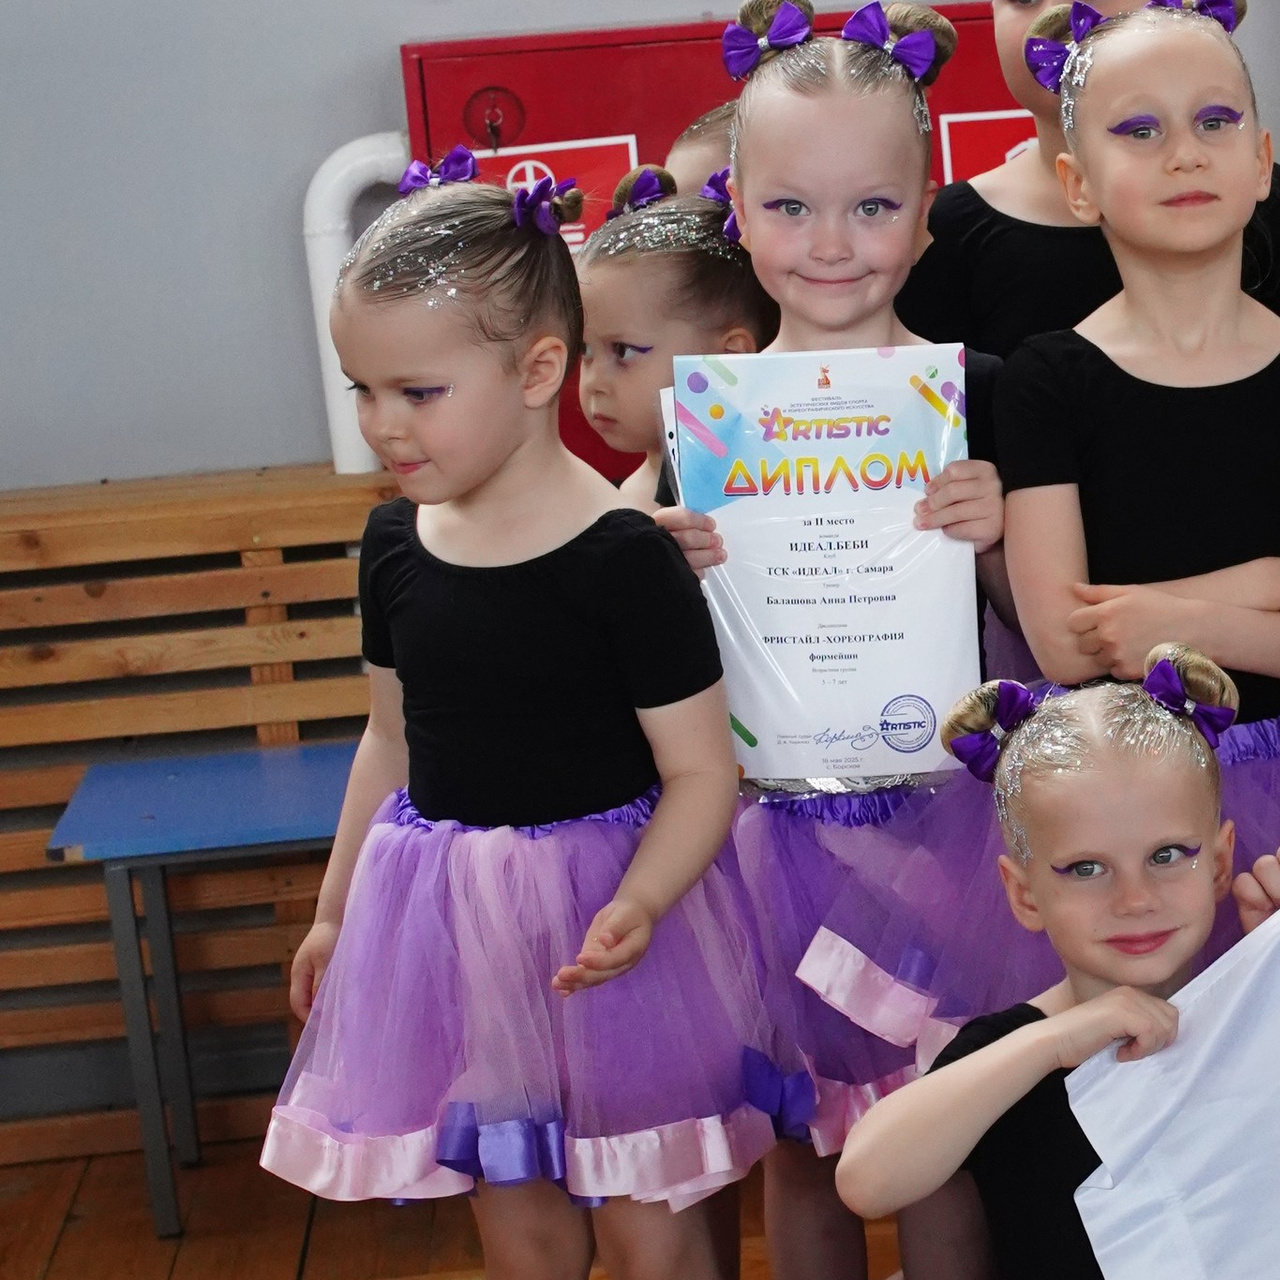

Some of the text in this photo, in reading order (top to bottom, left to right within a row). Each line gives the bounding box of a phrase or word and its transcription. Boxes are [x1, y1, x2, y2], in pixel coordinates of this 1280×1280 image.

[758, 407, 891, 442] ARTISTIC
[723, 449, 931, 496] ДИПЛОМ
[802, 519, 812, 527] за
[826, 517, 855, 526] место
[789, 540, 869, 552] ИДЕАЛ.БЕБИ
[766, 567, 790, 576] ТСК
[792, 567, 843, 577] «ИДЕАЛ»
[856, 565, 894, 574] Самара
[766, 594, 897, 605] Балашова Анна Петровна
[762, 634, 820, 644] ФРИСТАЙЛ
[879, 719, 926, 731] ARTISTIC
